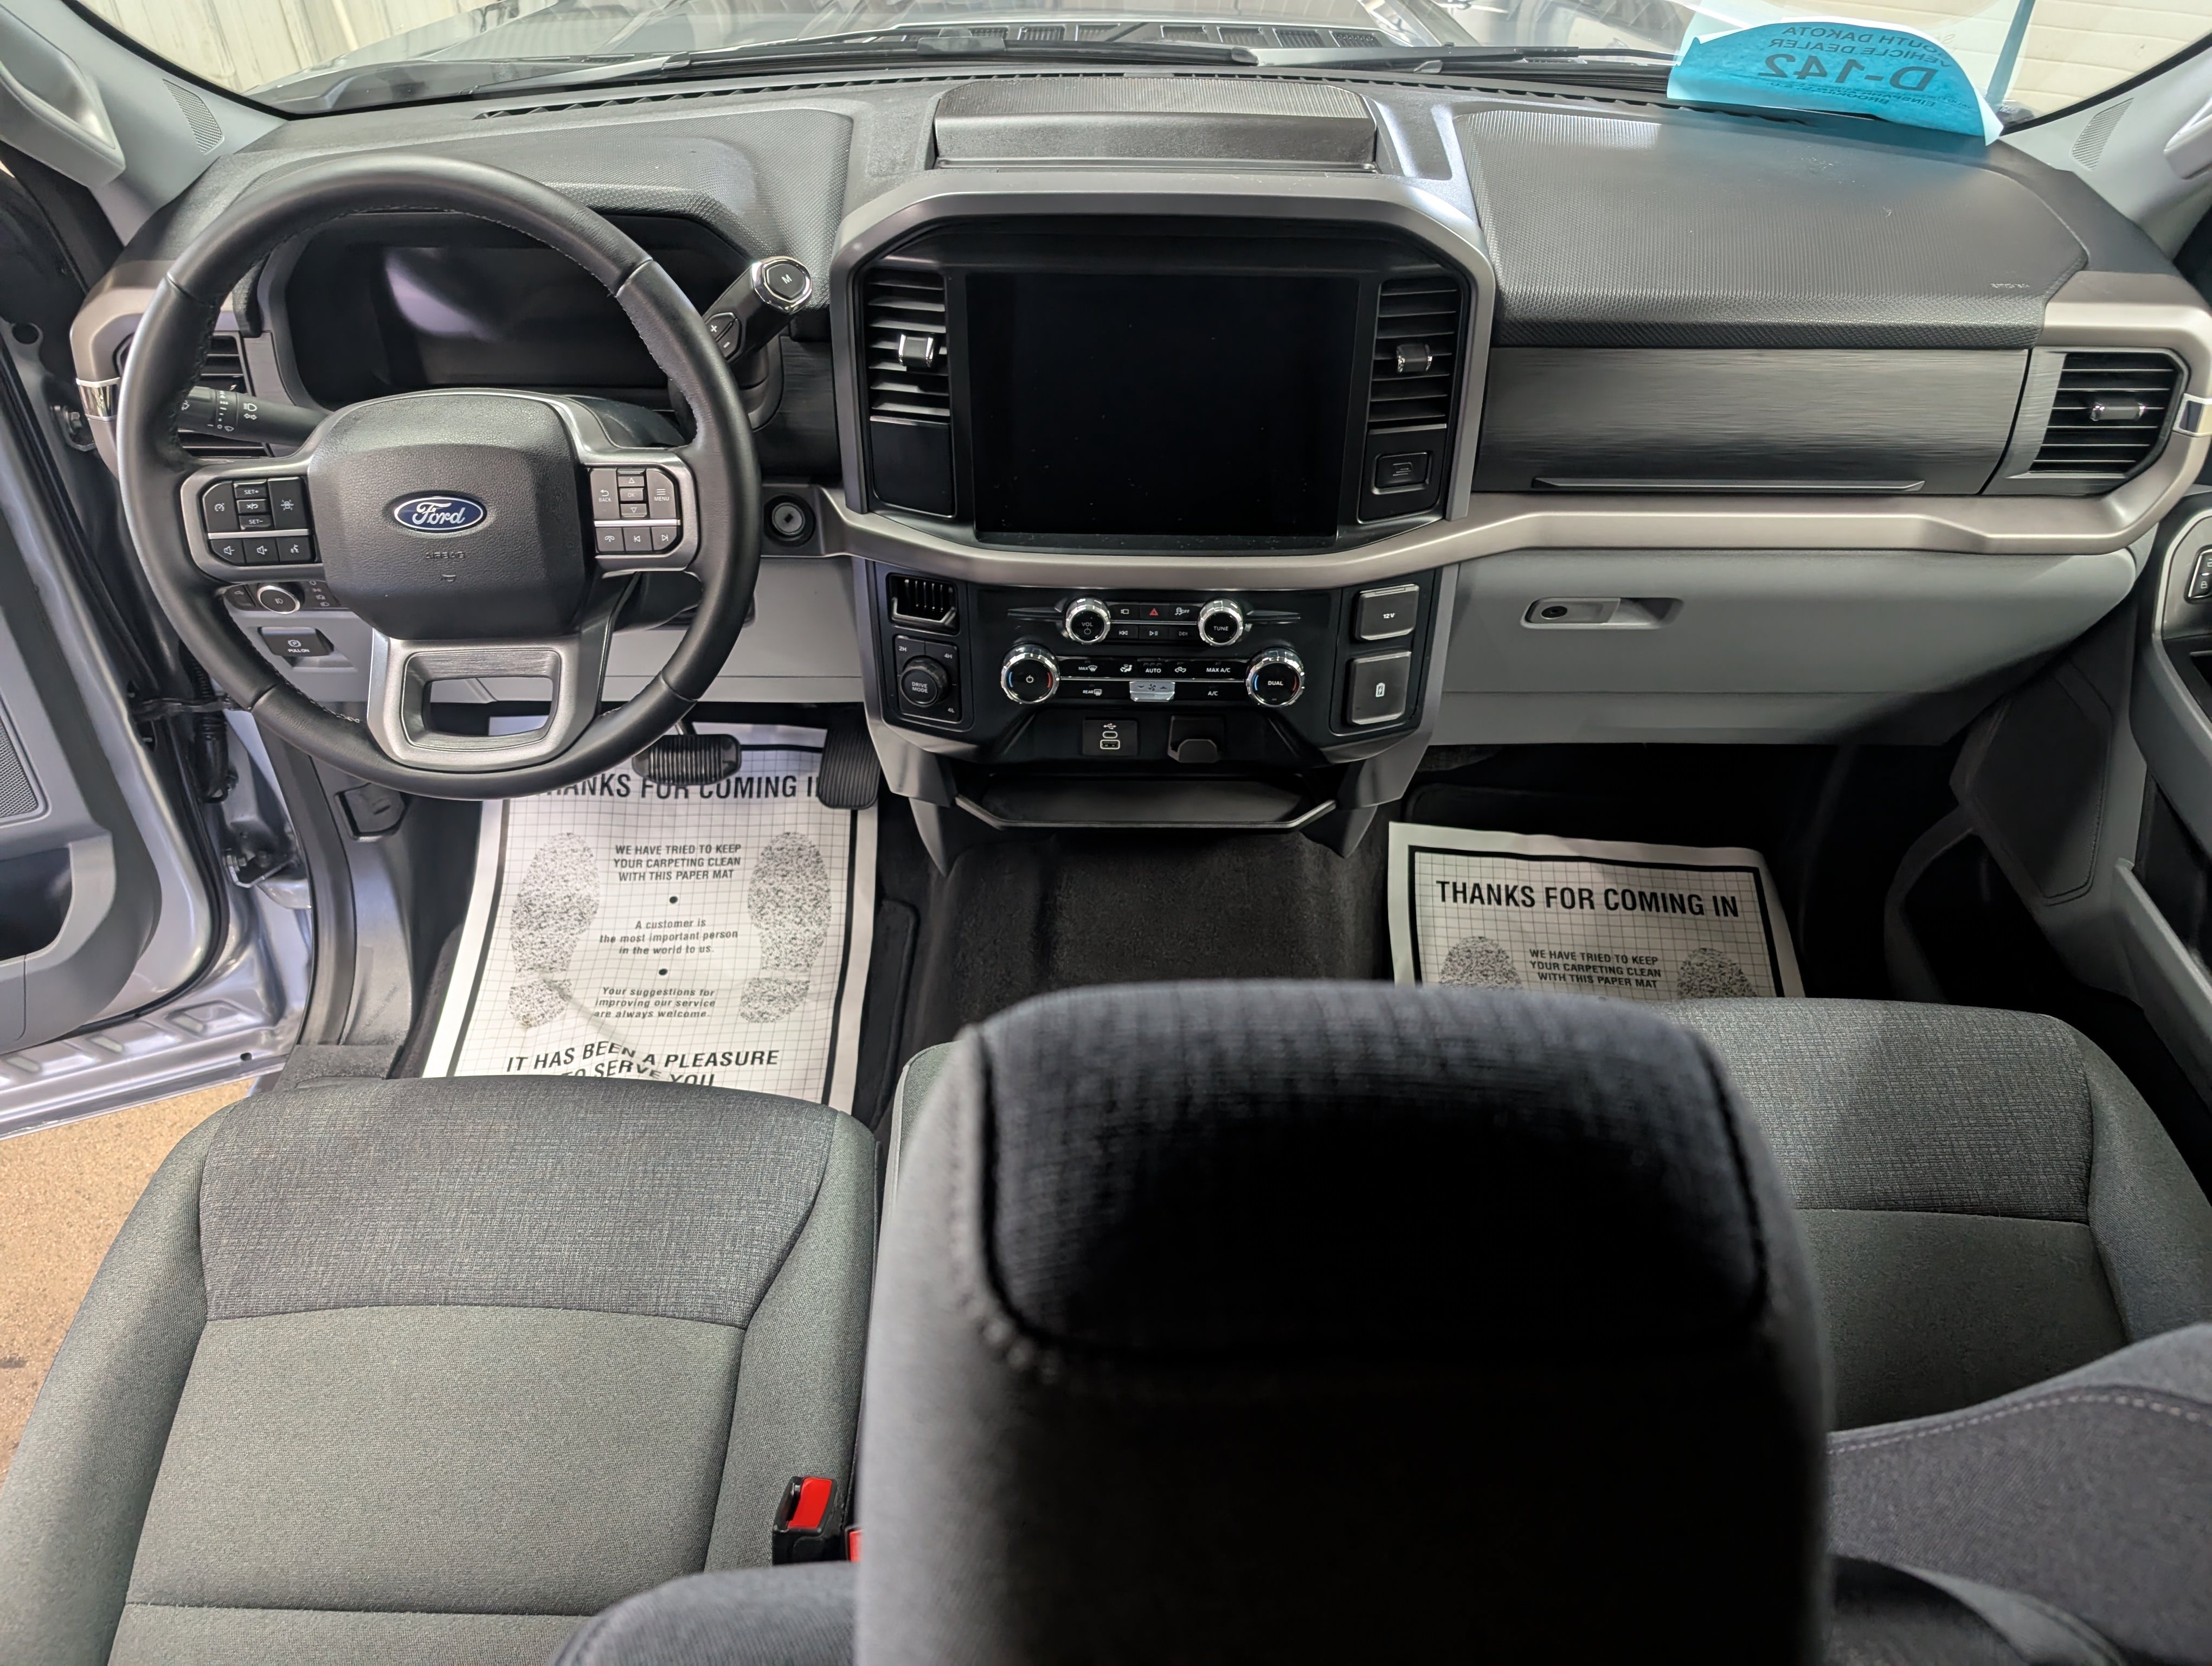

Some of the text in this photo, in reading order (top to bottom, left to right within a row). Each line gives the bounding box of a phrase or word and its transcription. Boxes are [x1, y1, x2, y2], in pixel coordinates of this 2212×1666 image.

[781, 274, 793, 284] M
[412, 502, 466, 524] Ford
[807, 777, 820, 797] I
[615, 844, 741, 855] WE HAVE TRIED TO KEEP
[614, 857, 741, 868] YOUR CARPETING CLEAN
[619, 869, 734, 881] WITH THIS PAPER MAT
[1436, 880, 1739, 918] THANKS FOR COMING IN
[635, 918, 706, 929] A customer is
[599, 931, 738, 943] the most important person
[619, 946, 628, 954] in
[633, 946, 649, 954] the
[653, 945, 682, 954] world
[699, 945, 714, 953] us.
[1529, 949, 1658, 965] WE HAVE TRIED TO KEEP
[1529, 960, 1661, 977] YOUR CARPETING CLEAN
[1537, 972, 1657, 988] WITH THIS PAPER MAT
[603, 986, 627, 995] Your
[630, 988, 696, 997] suggestions
[595, 998, 650, 1008] improving
[675, 999, 716, 1007] service
[615, 1010, 653, 1019] always
[658, 1010, 710, 1018] welcome.
[507, 1041, 780, 1072] IT HAS BEEN A PLEASURE
[594, 1060, 662, 1079] SERVE
